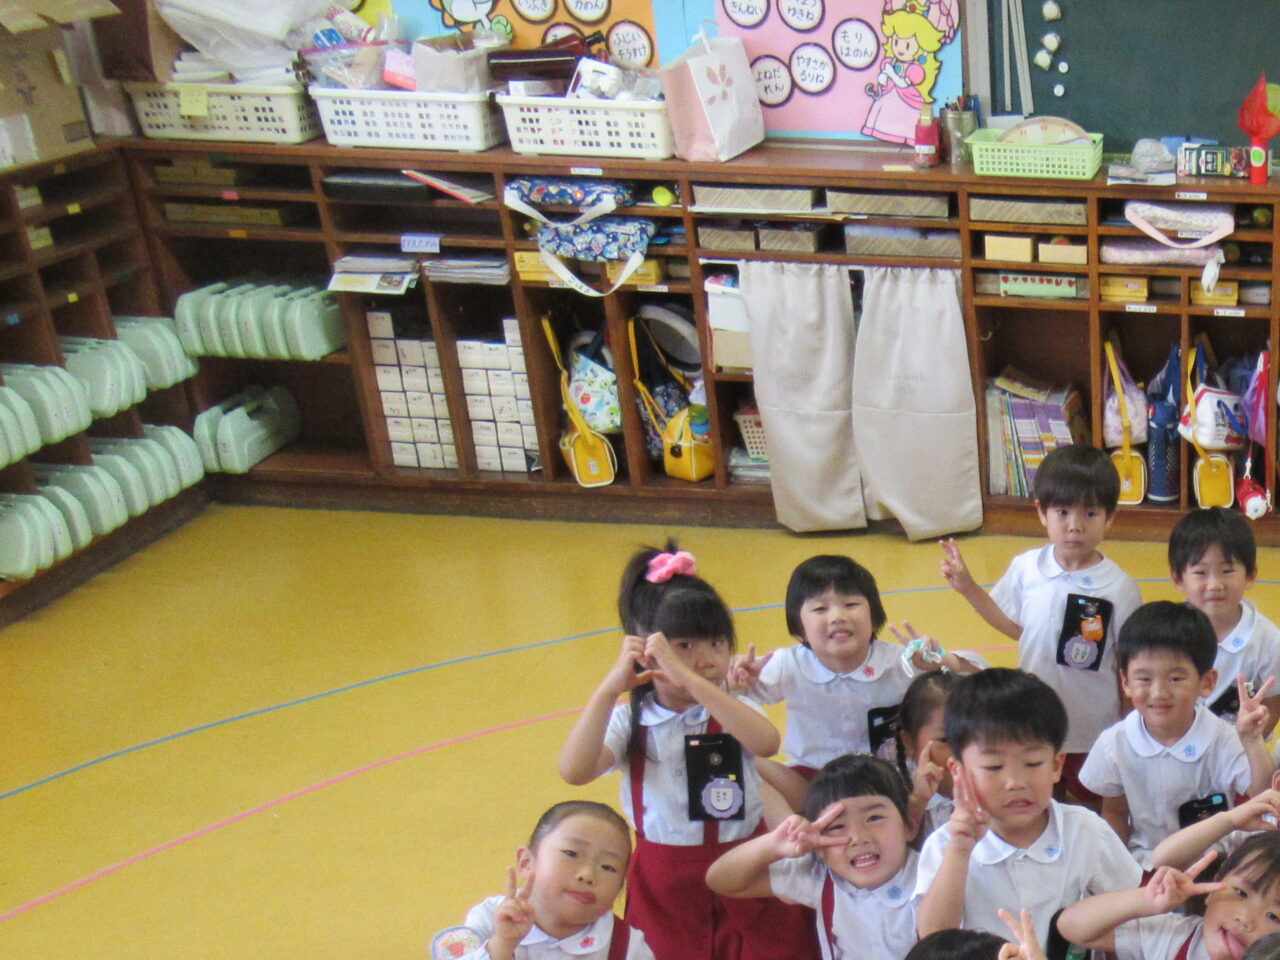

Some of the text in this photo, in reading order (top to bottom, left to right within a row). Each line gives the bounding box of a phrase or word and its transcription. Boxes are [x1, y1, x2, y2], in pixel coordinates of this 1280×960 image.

[841, 29, 864, 43] もり
[840, 46, 874, 59] はのん
